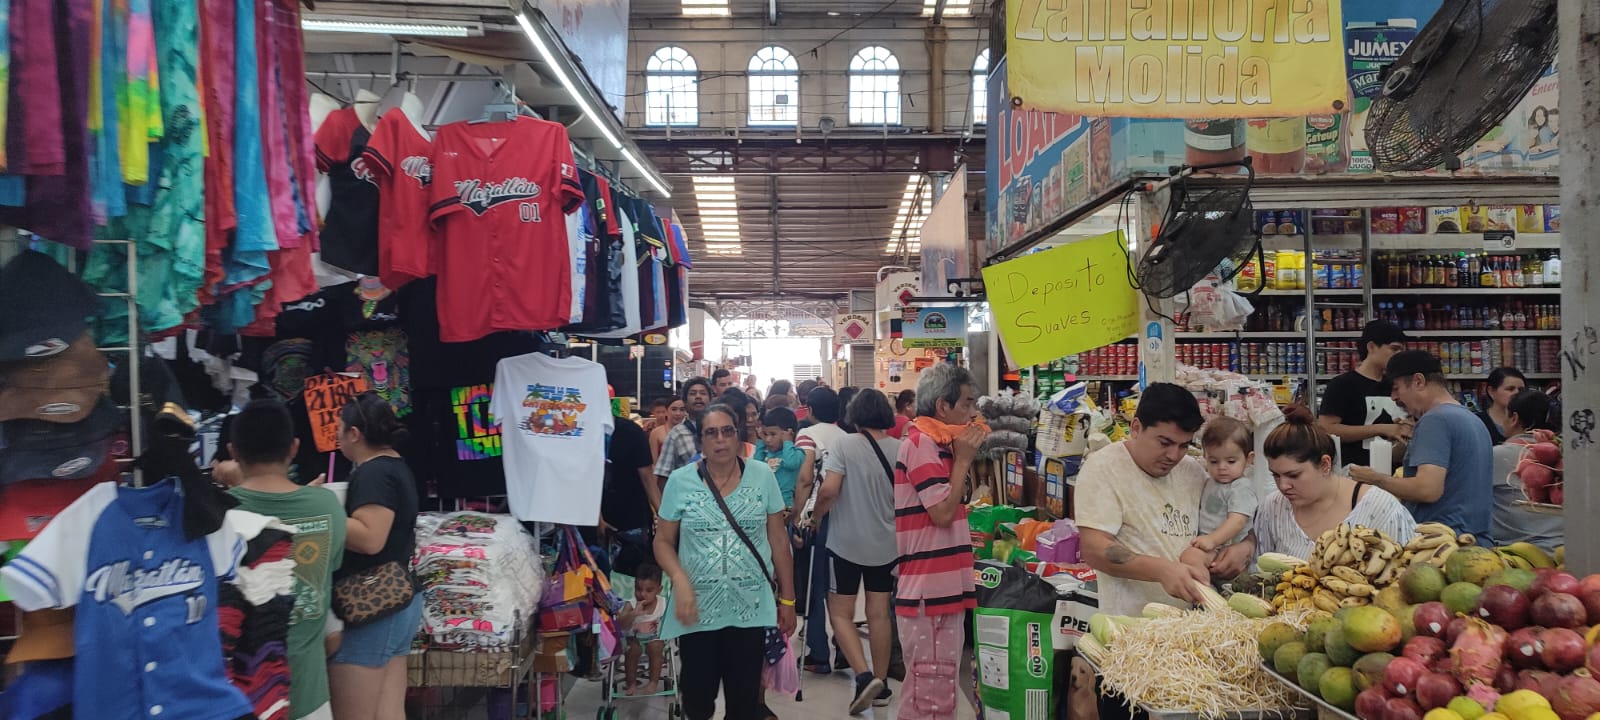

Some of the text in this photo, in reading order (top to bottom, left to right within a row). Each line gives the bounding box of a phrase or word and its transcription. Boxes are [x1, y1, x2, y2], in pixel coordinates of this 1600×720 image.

[1075, 45, 1272, 105] Molida
[520, 202, 541, 223] 01
[1015, 310, 1091, 344] Suaves
[1031, 623, 1042, 673] PERRON
